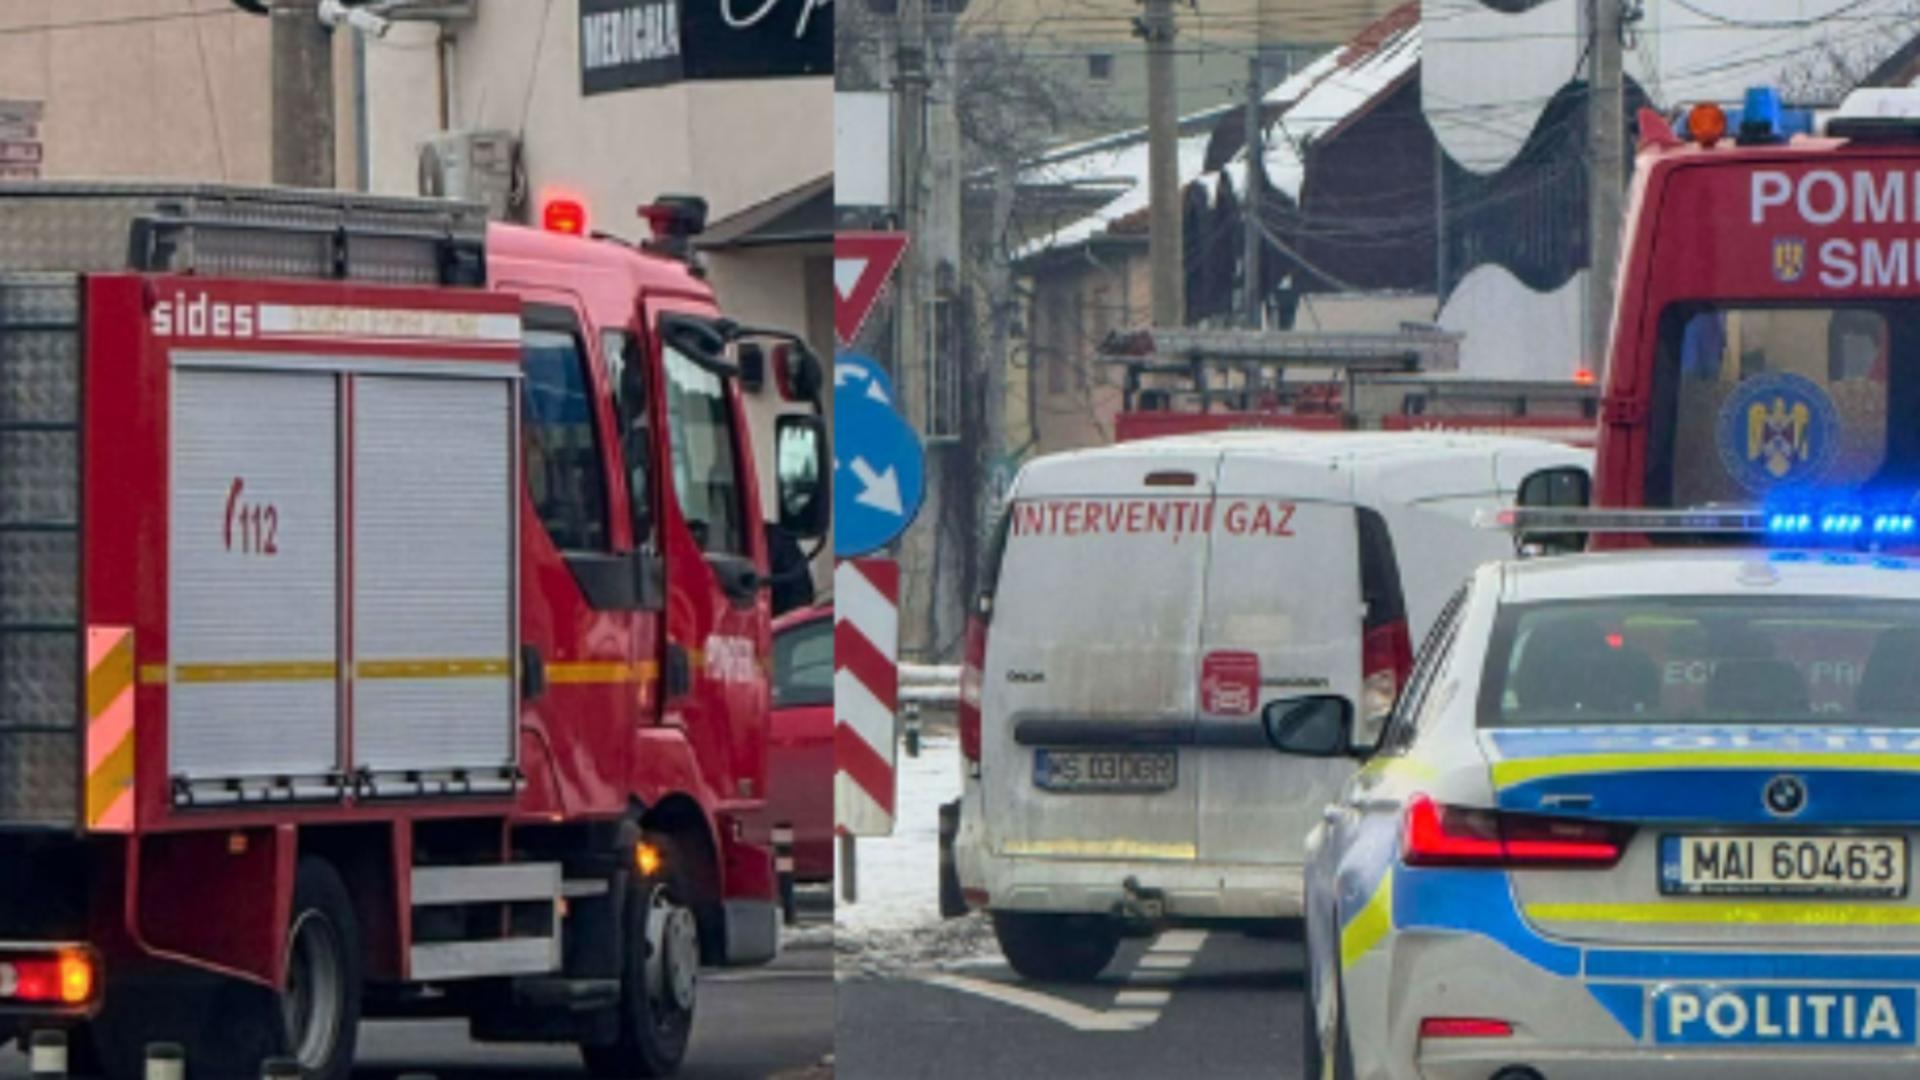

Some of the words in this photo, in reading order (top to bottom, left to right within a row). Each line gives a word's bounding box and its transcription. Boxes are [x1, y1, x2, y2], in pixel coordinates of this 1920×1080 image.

[151, 291, 253, 337] sides
[239, 503, 279, 556] 112
[1224, 502, 1297, 537] GAZ
[1693, 841, 1754, 880] MAI
[1771, 841, 1896, 881] 60463
[1669, 992, 1902, 1038] POLITIA
